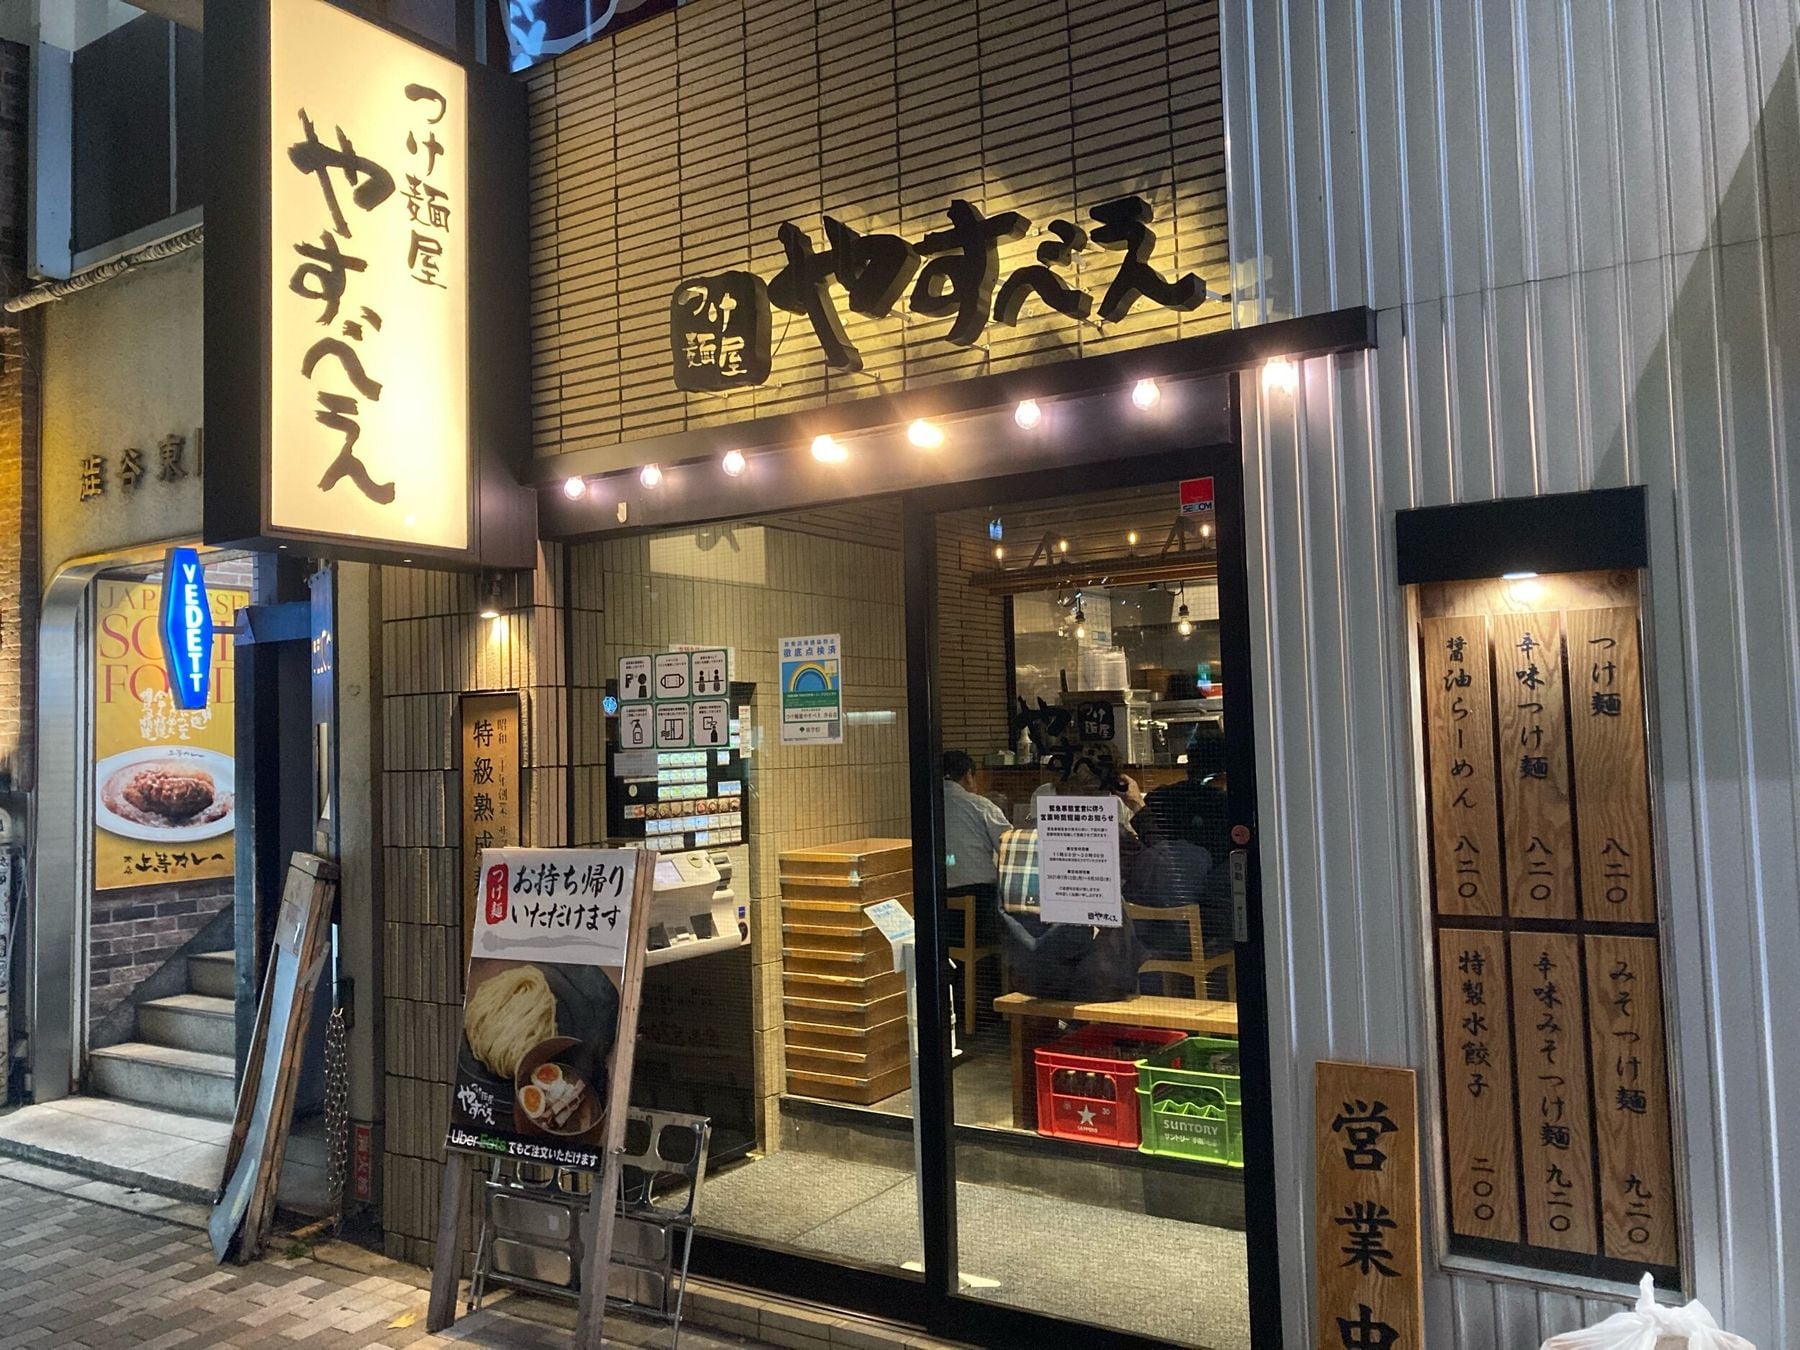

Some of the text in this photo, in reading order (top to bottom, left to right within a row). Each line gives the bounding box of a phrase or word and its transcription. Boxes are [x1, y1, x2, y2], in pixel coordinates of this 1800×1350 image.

[400, 83, 450, 290] つけ麺屋
[287, 107, 396, 505] やすべえ
[768, 194, 1207, 372] やすべえ
[182, 563, 204, 694] VEDETT
[1588, 635, 1622, 717] つけ麺
[1443, 636, 1478, 809] 醤油らーめん
[1515, 631, 1549, 780] 辛味つけ麺
[487, 868, 505, 918] つけ麺
[511, 902, 621, 932] いただけます
[513, 863, 625, 899] お持ち帰り
[1457, 950, 1492, 1098] 特製水餃子
[1532, 951, 1571, 1150] 辛味みそつけ麺
[1609, 960, 1648, 1115] みそつけ麺
[451, 1129, 599, 1168] Uber Eats でもご注文いただけます
[1163, 1119, 1219, 1136] SUNTORY
[1331, 1099, 1402, 1350] 営業中
